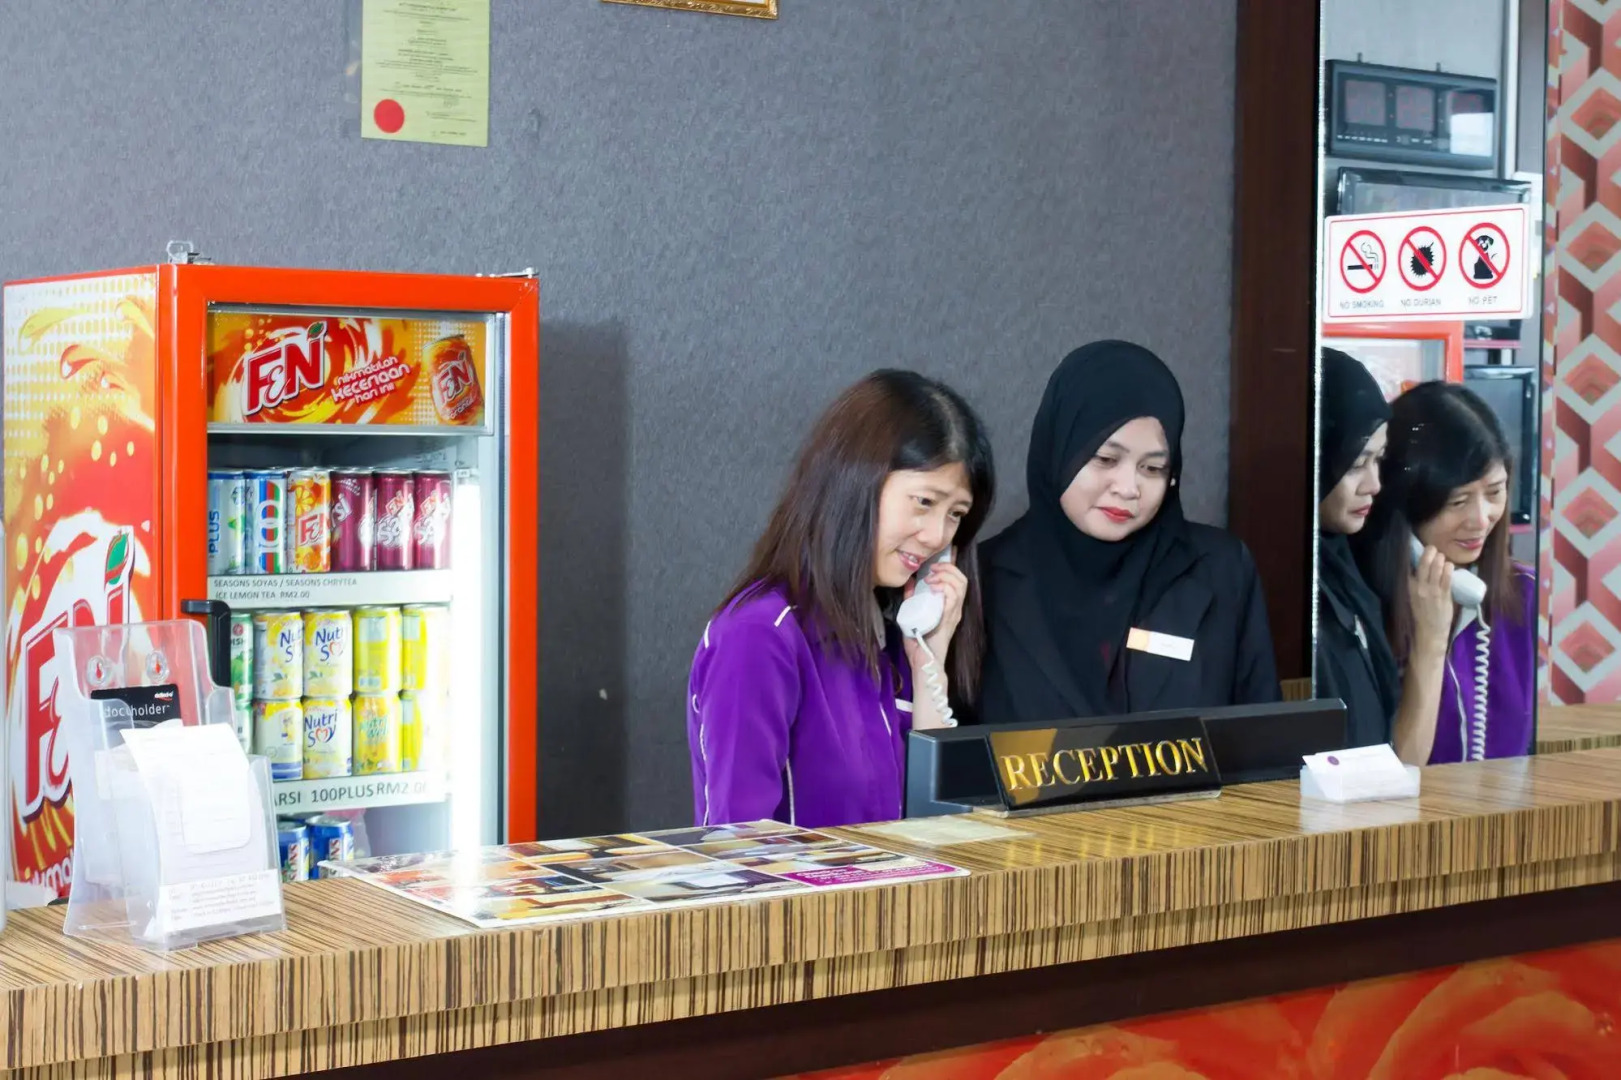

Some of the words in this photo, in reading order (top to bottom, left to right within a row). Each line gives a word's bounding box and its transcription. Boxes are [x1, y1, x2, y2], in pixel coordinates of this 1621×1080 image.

[1352, 300, 1385, 309] SMOKING
[1482, 296, 1498, 304] PET
[245, 328, 327, 414] F&N
[213, 579, 250, 588] SEASONS
[252, 579, 278, 588] SOYAS
[286, 578, 321, 587] SEASONS
[229, 591, 260, 599] LEMON
[261, 591, 276, 599] TEA
[304, 708, 338, 733] Nutri
[1000, 737, 1209, 791] RECEPTION
[311, 784, 374, 803] 100PLUS
